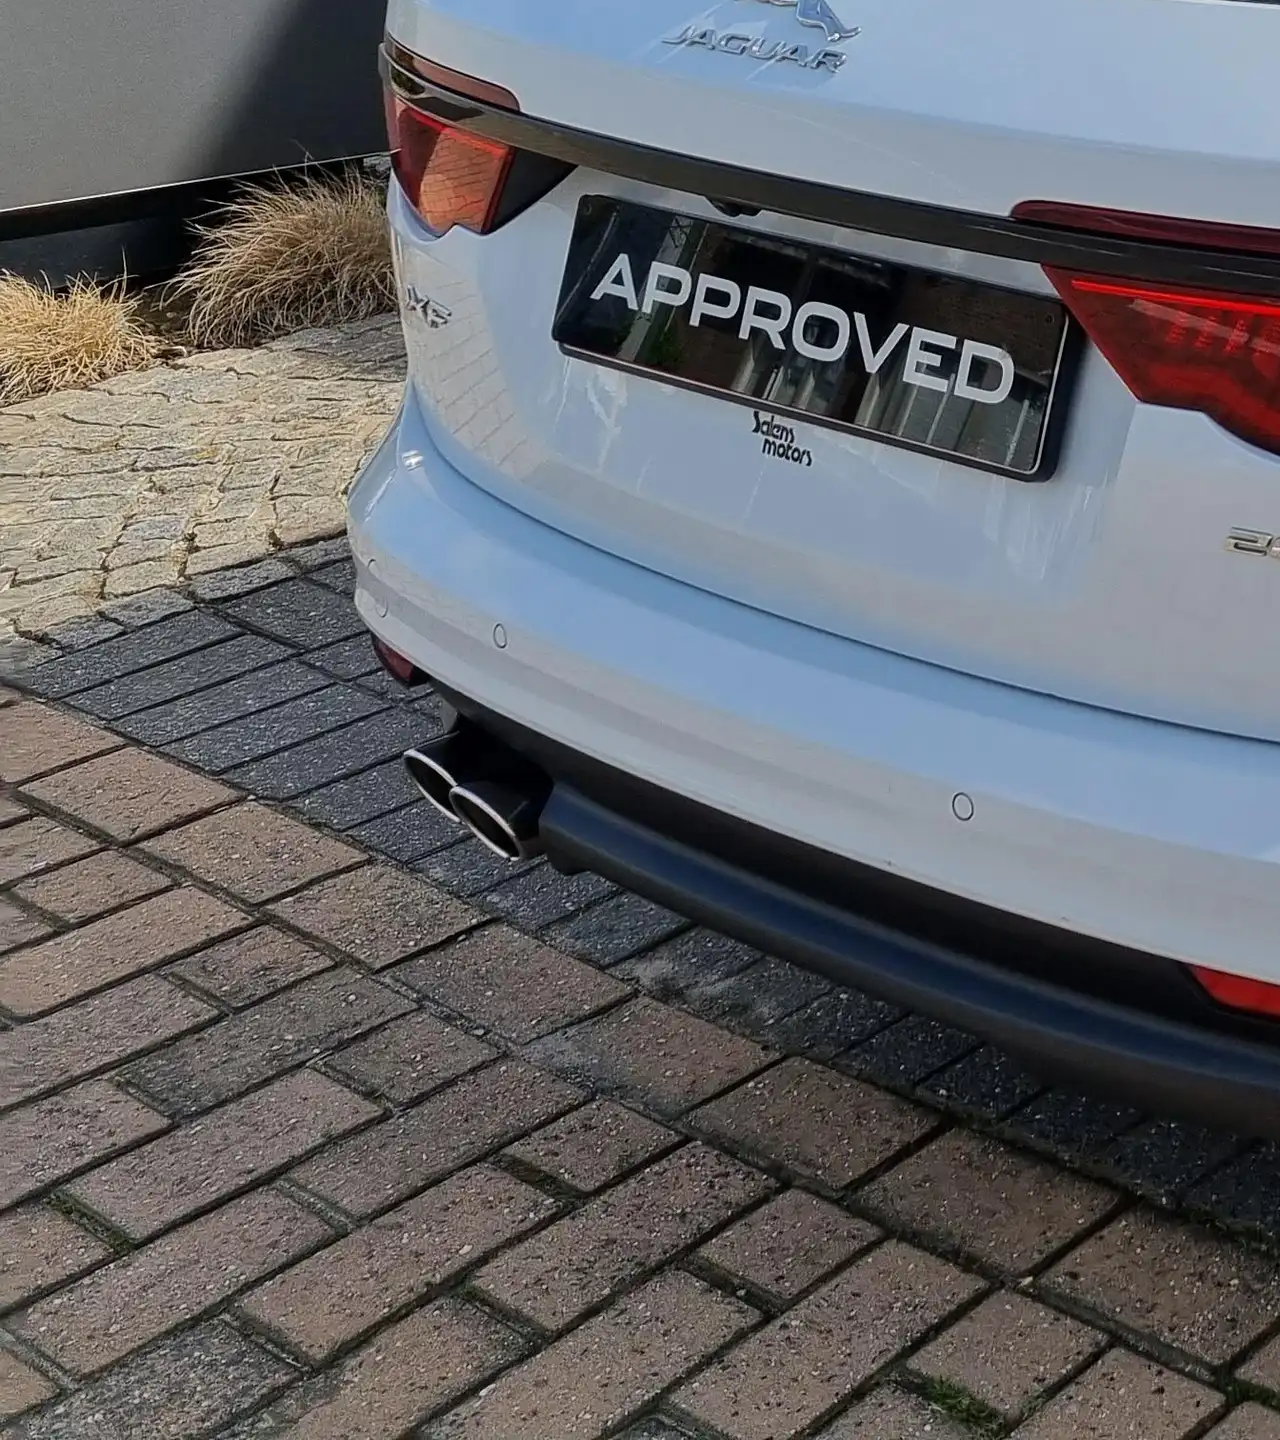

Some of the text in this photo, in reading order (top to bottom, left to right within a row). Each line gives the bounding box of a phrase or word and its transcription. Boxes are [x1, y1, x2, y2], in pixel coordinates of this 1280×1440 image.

[661, 25, 847, 74] JAGUAR
[590, 253, 1015, 404] APPROVED
[752, 411, 796, 444] Salens
[762, 438, 812, 467] motors
